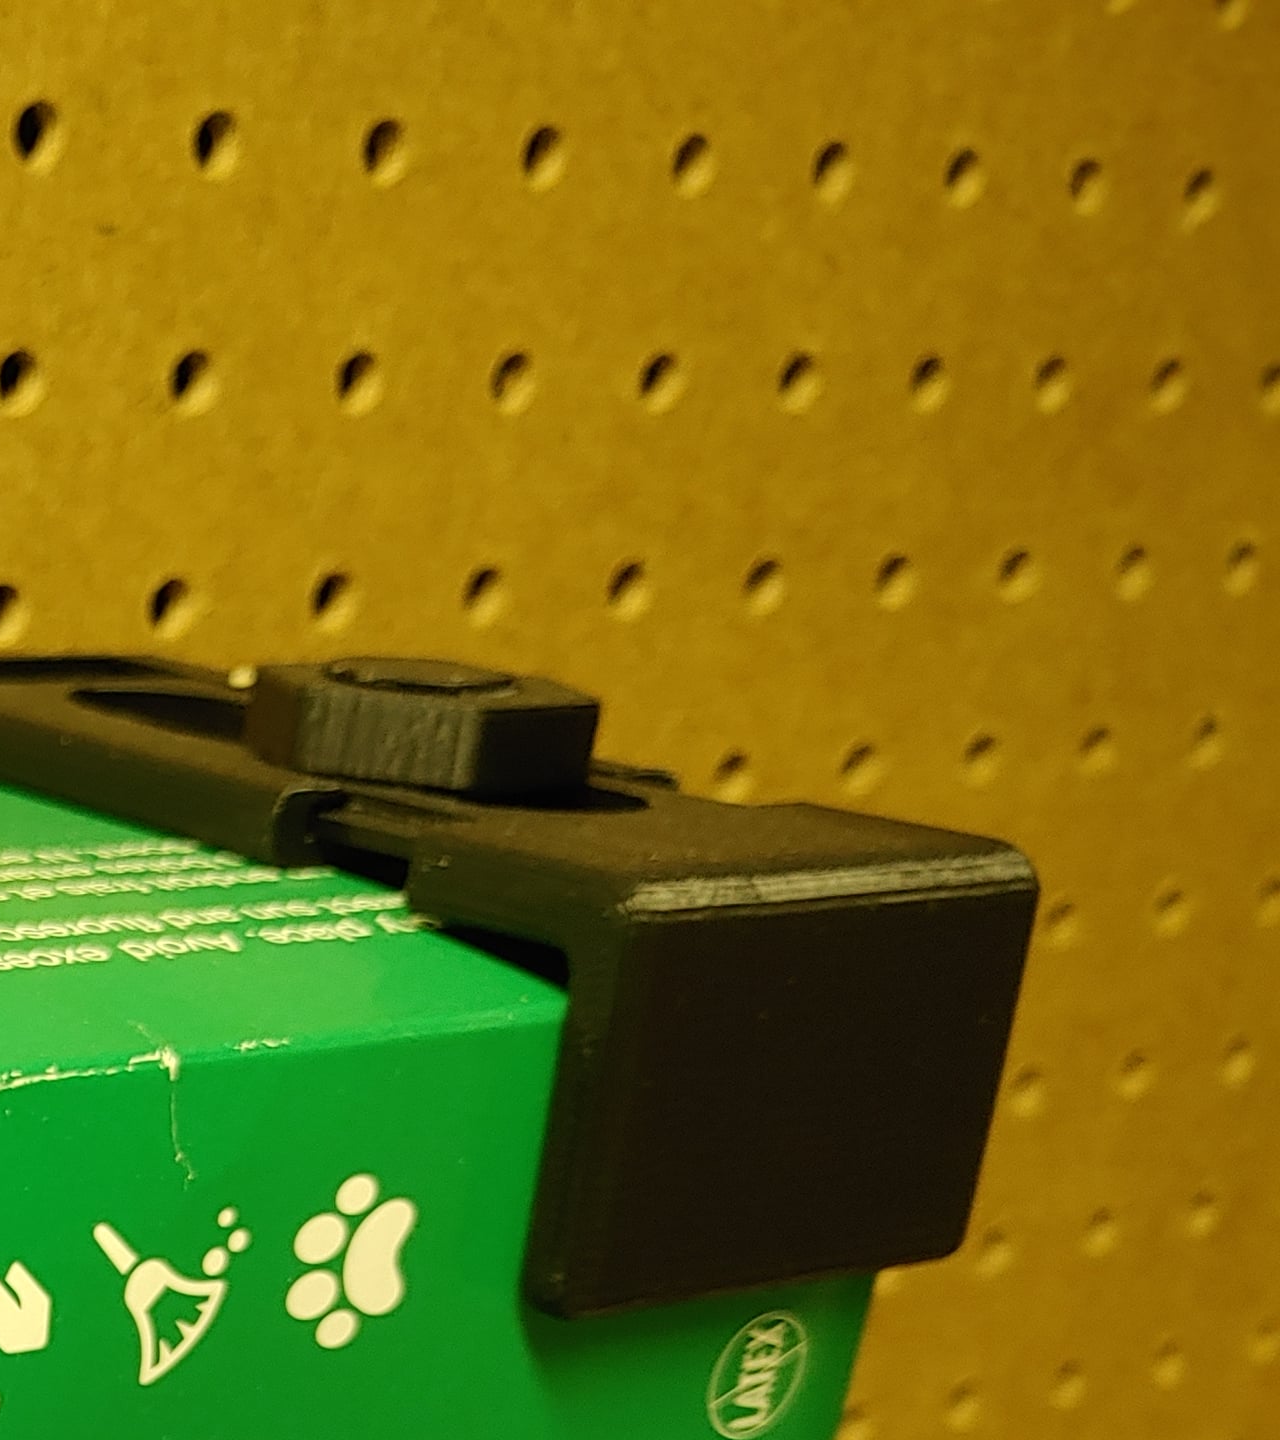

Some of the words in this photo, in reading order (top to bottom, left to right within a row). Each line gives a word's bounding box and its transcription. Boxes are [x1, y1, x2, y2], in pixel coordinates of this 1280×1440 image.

[51, 877, 152, 897] frais
[156, 906, 241, 930] and
[238, 899, 321, 920] sun
[245, 918, 373, 944] place.
[117, 932, 241, 962] Avoid
[727, 1320, 786, 1430] LATEX
